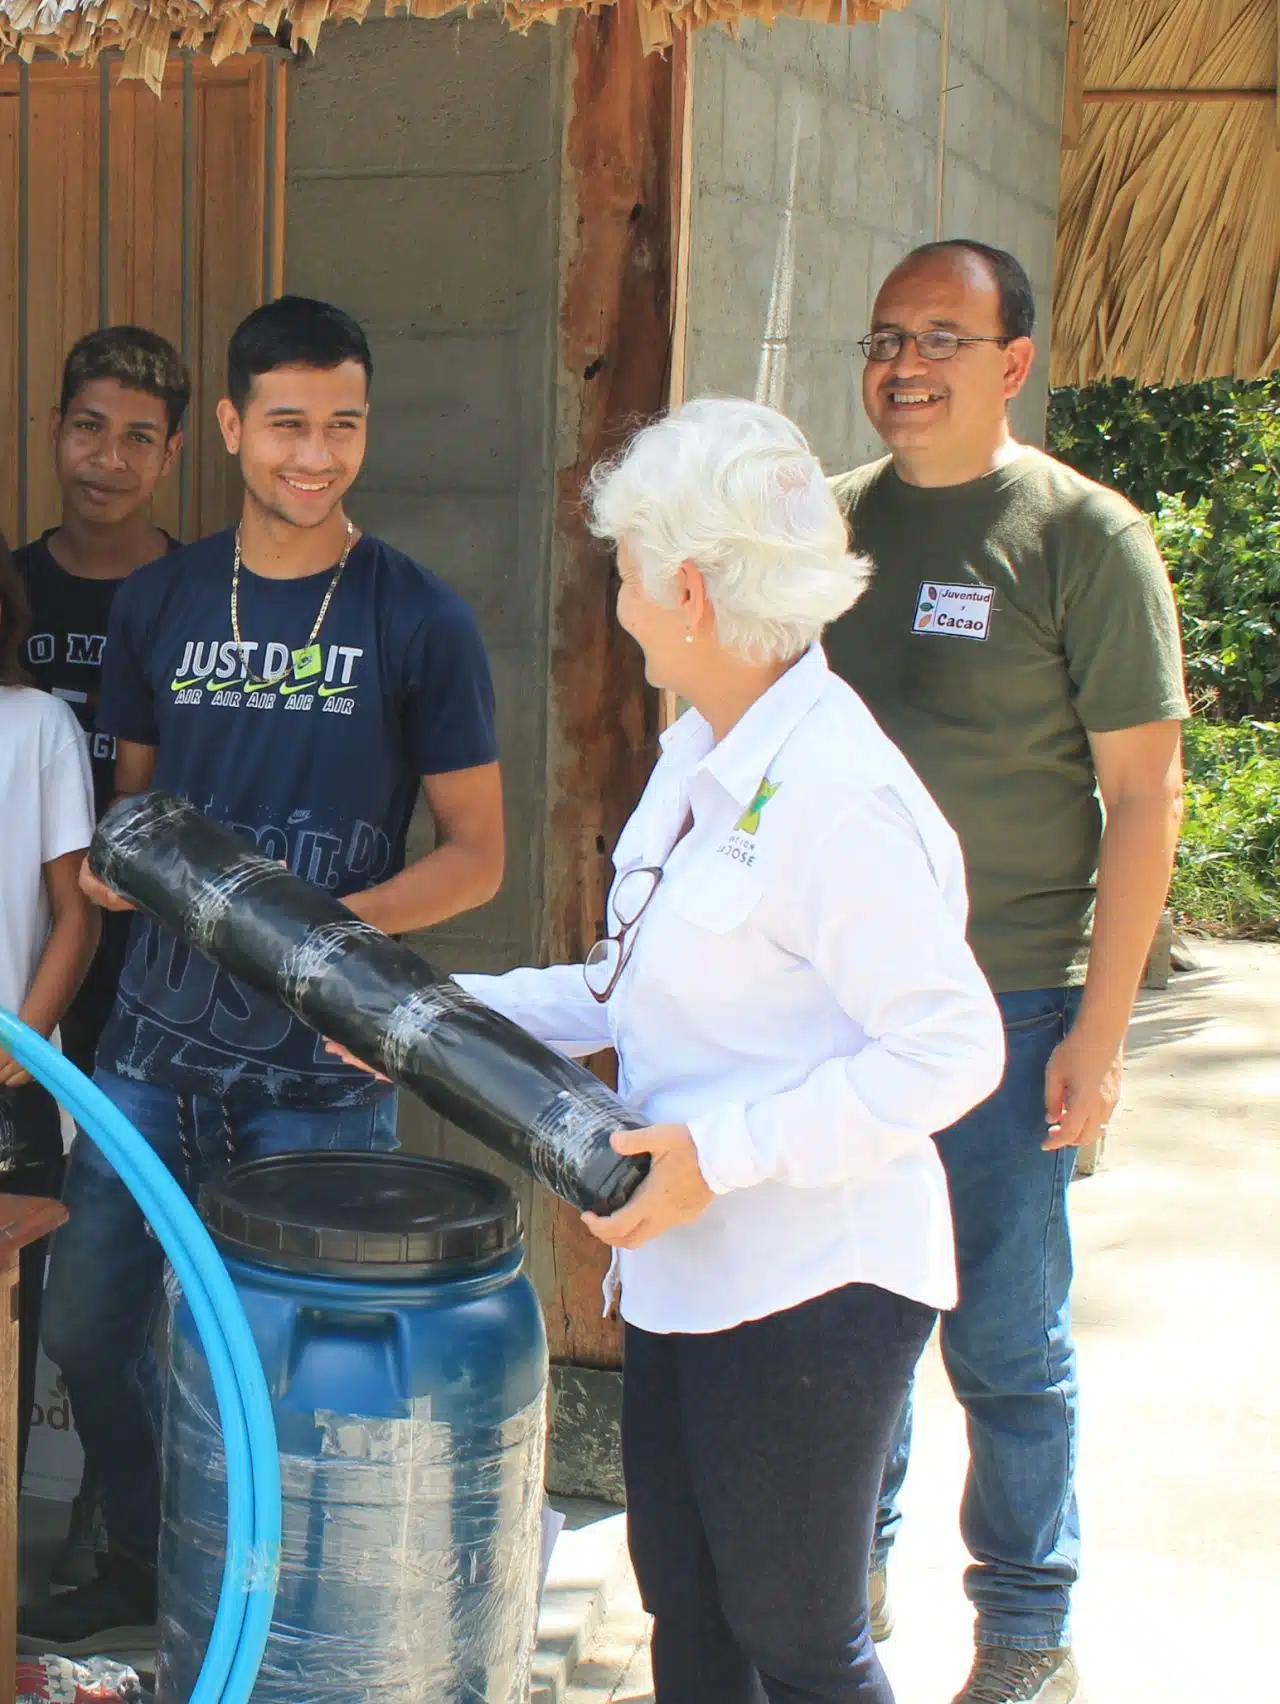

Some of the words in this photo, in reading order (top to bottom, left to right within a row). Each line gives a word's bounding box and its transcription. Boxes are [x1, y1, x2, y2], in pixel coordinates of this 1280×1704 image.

[941, 589, 991, 602] Juventud
[937, 613, 984, 631] Cacao
[176, 641, 259, 678] JUST
[325, 645, 363, 684] IT
[175, 689, 202, 704] AIR
[211, 691, 241, 707] AIR
[246, 692, 276, 709] AIR
[285, 694, 314, 710] AIR
[323, 697, 354, 714] AIR
[30, 1399, 69, 1432] od
